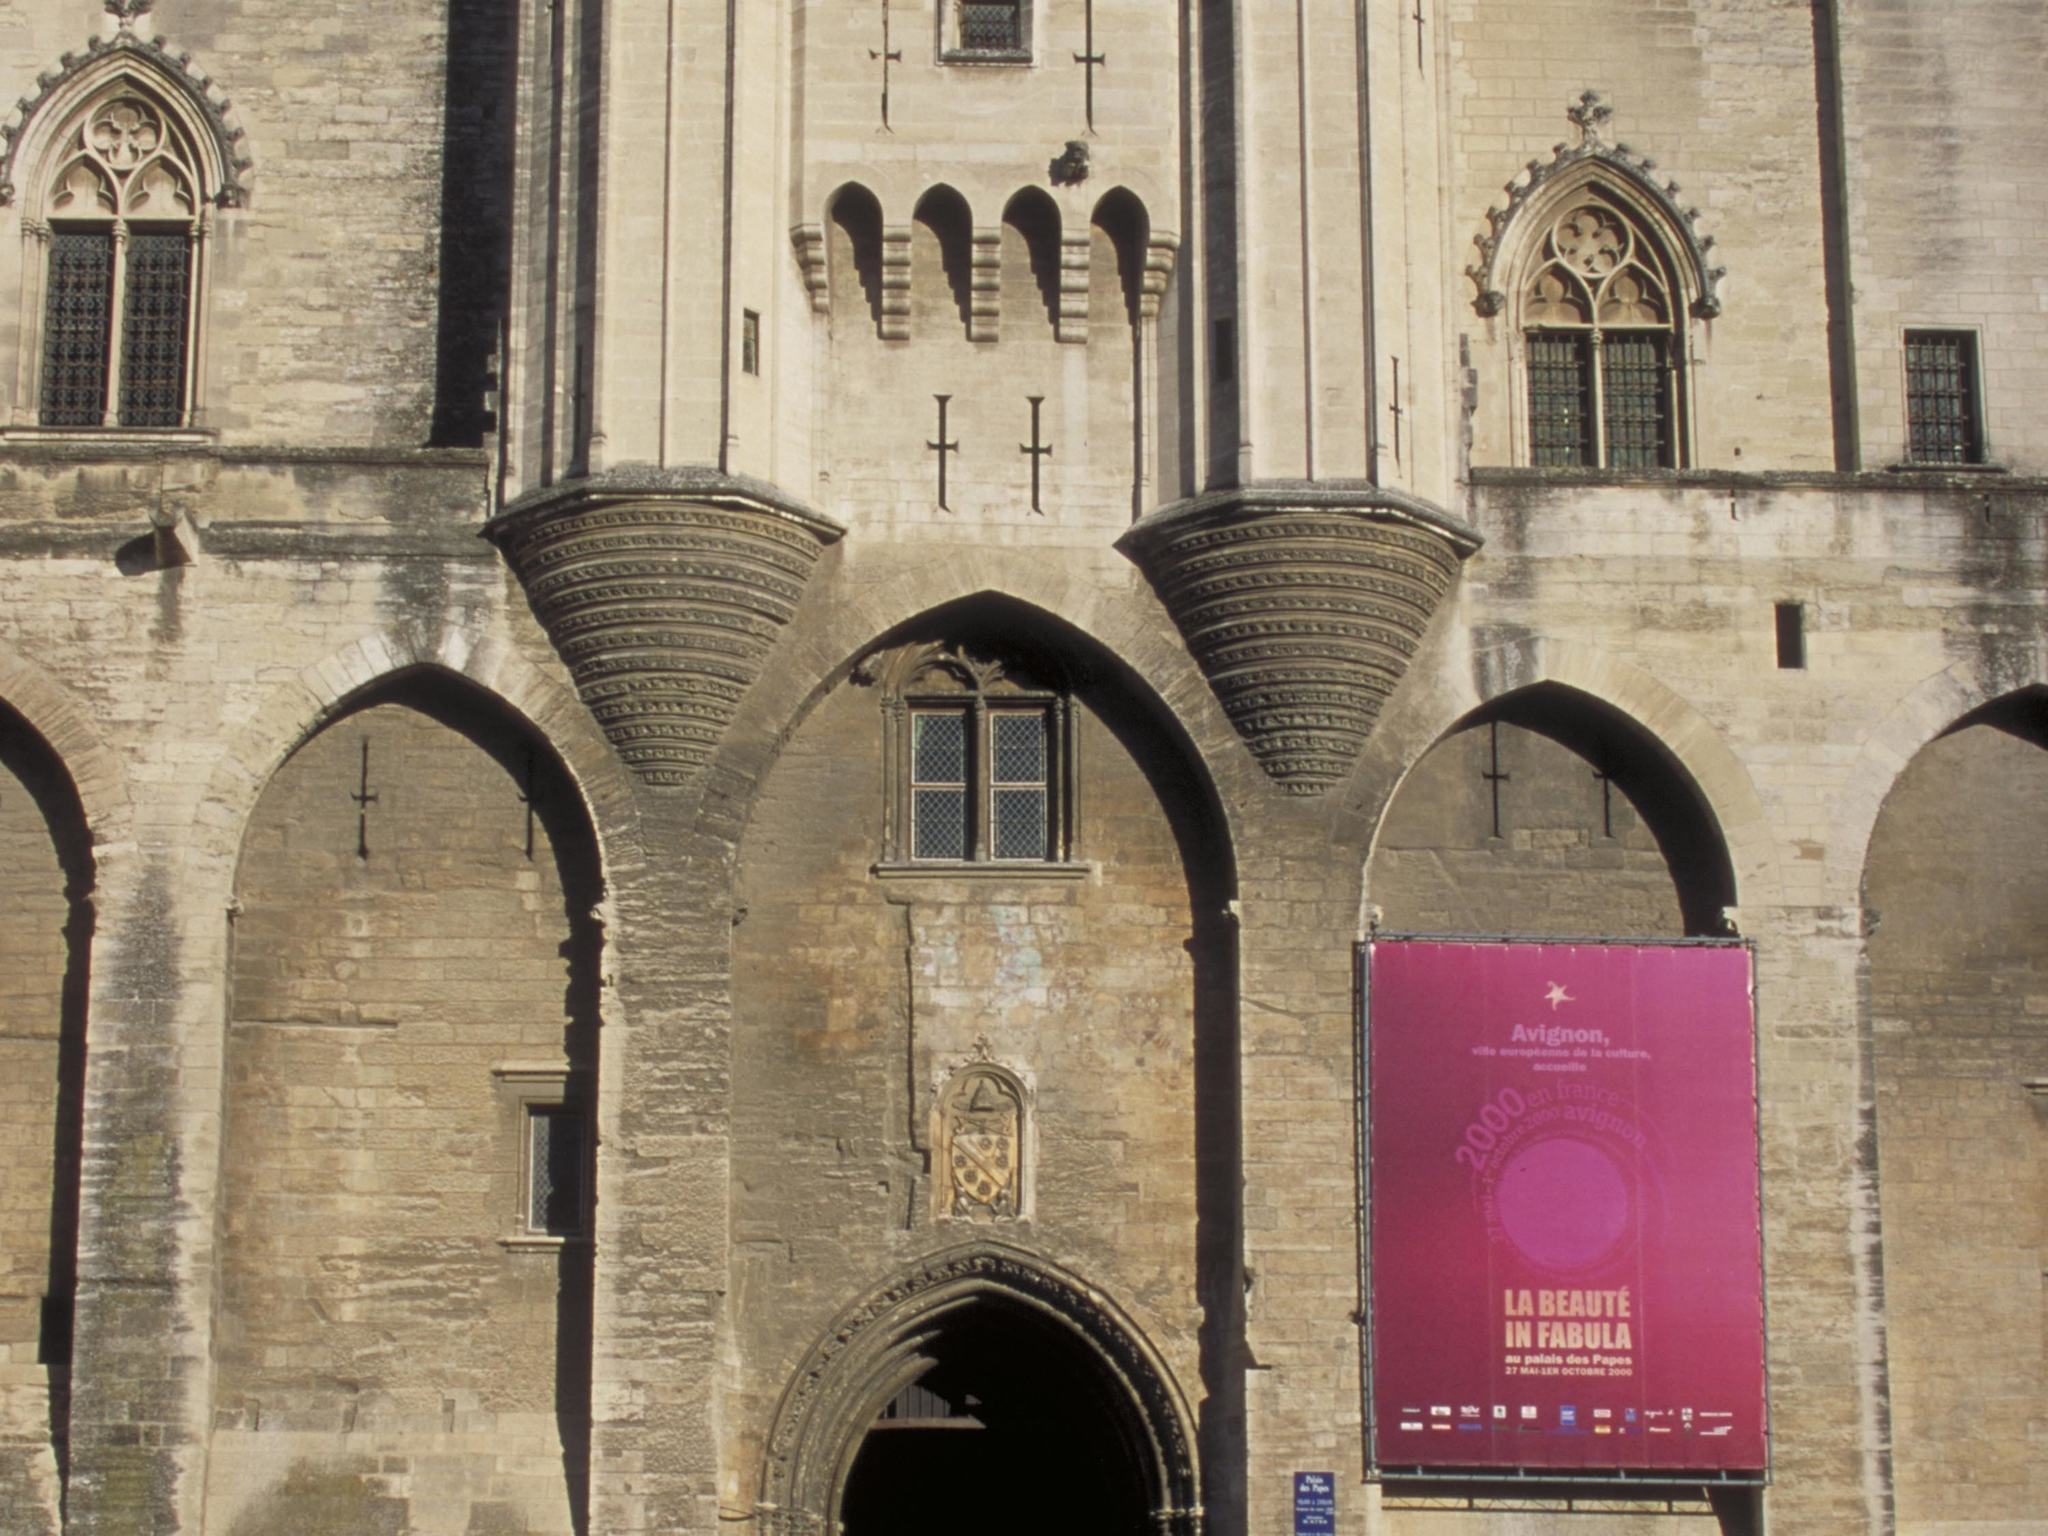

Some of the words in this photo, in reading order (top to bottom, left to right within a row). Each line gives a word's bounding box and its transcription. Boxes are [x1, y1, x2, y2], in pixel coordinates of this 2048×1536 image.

[1511, 1023, 1611, 1048] Avignon,
[1471, 1045, 1496, 1056] ville
[1499, 1047, 1570, 1058] européenne
[1573, 1047, 1588, 1057] de
[1590, 1048, 1603, 1058] la
[1455, 1087, 1525, 1170] 2000
[1526, 1086, 1553, 1107] en
[1557, 1077, 1620, 1107] france
[1563, 1102, 1648, 1149] avignon
[1505, 1289, 1534, 1317] LA
[1538, 1285, 1631, 1317] BEAUTÉ
[1505, 1321, 1532, 1348] IN
[1538, 1321, 1632, 1349] FABULA
[1505, 1355, 1521, 1364] au
[1525, 1354, 1563, 1366] palais
[1566, 1354, 1590, 1365] des
[1592, 1354, 1632, 1367] Papes
[1505, 1366, 1517, 1375] 27
[1561, 1367, 1605, 1376] OCTOBRE
[1608, 1367, 1633, 1376] 2000
